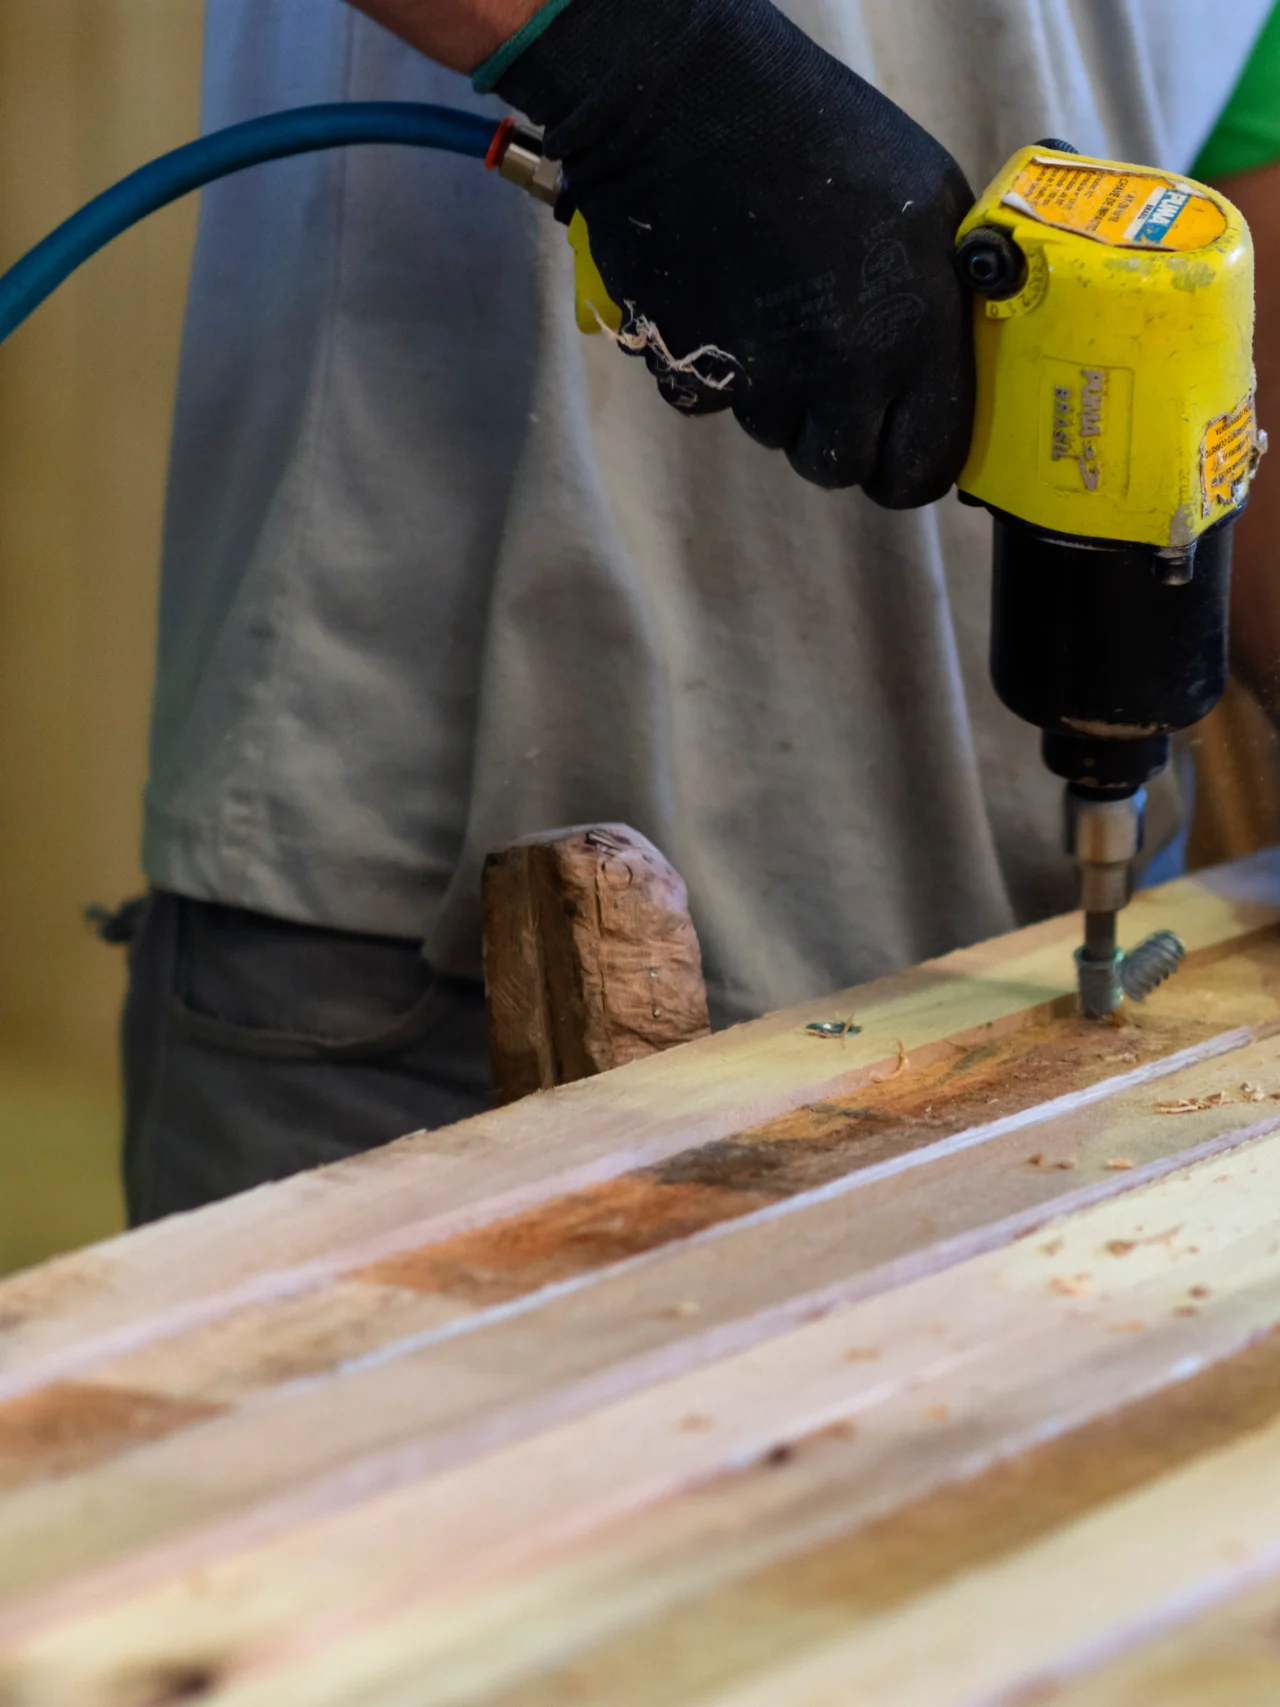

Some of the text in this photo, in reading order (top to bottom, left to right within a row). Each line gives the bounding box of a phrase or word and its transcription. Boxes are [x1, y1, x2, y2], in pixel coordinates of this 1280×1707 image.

[1137, 204, 1154, 220] BRASIL
[1147, 191, 1188, 226] PUMA
[1052, 385, 1071, 461] BRASIL
[1080, 369, 1103, 437] PUMA
